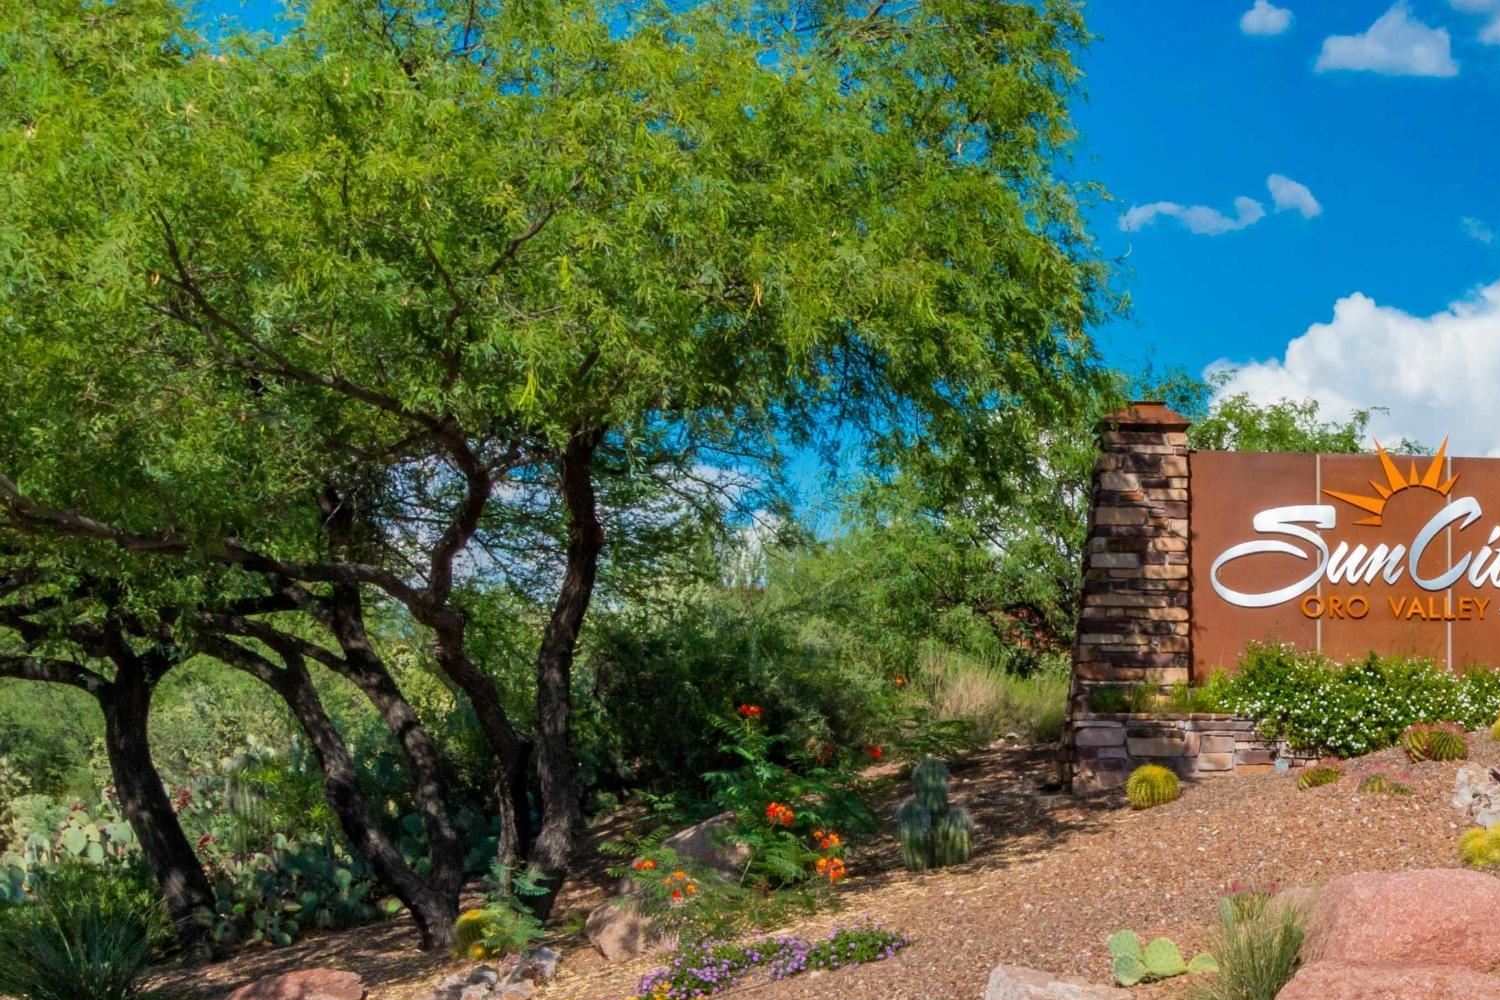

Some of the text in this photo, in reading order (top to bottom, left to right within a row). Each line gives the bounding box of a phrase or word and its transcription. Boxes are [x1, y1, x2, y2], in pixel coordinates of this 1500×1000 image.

[1210, 504, 1406, 608] Sun
[1301, 594, 1491, 620] ORO VALLEY
